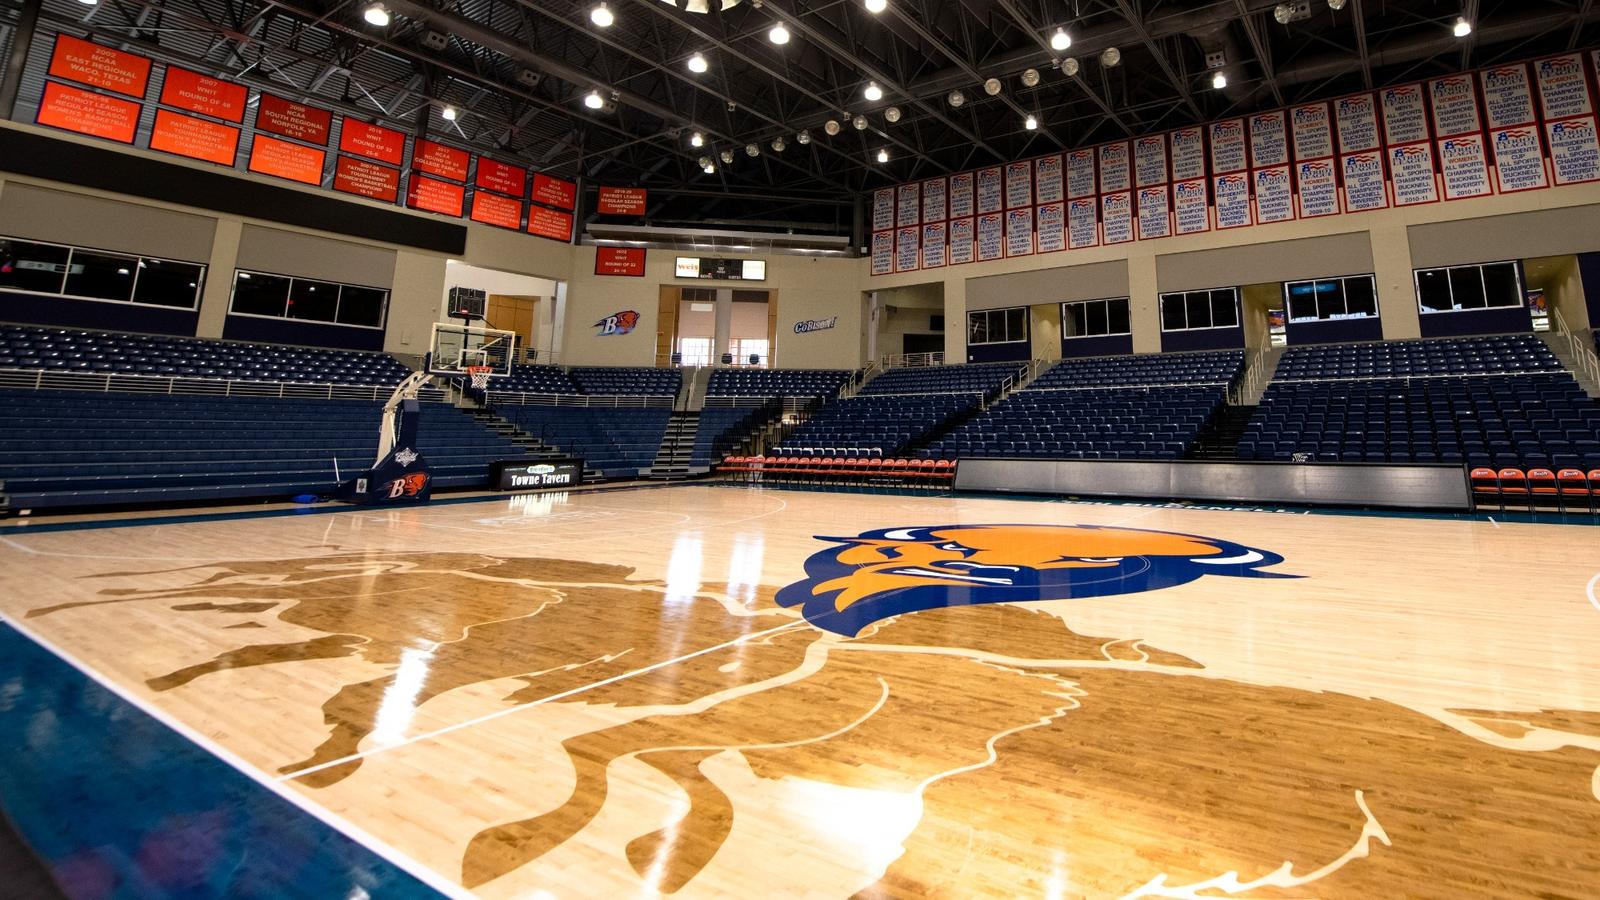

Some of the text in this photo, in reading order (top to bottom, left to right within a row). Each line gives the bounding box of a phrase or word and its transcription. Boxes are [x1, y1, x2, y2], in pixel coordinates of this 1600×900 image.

[95, 47, 116, 58] 2002
[90, 53, 117, 65] NCAA
[64, 53, 137, 79] EAST REGIONAL
[102, 71, 131, 85] TEXAS
[1544, 73, 1577, 84] WOMEN'S
[1556, 79, 1584, 89] SPORTS
[1543, 85, 1584, 98] CHAMPIONS
[178, 89, 208, 102] ROUND
[208, 98, 220, 106] OF
[1546, 92, 1583, 104] BUCKNELL
[1546, 99, 1586, 110] UNIVERSITY
[286, 109, 305, 119] NCAA
[1553, 107, 1582, 116] 2001-02
[264, 109, 324, 130] SOUTH REGIONAL
[307, 127, 317, 135] VA
[365, 133, 381, 141] WNIT
[352, 137, 375, 148] ROUND
[375, 143, 384, 151] OF
[1567, 144, 1583, 152] CUP
[1569, 148, 1598, 157] SPORTS
[1447, 154, 1477, 164] WOMEN'S
[1457, 160, 1483, 168] SPORTS
[1513, 156, 1540, 165] SPORTS
[1556, 154, 1598, 165] CHAMPIONS
[1402, 163, 1420, 171] MEN'S
[1500, 162, 1540, 173] CHAMPIONS
[1558, 160, 1597, 170] BUCKNELL
[346, 164, 390, 179] PATRIOT LEAGUE
[1406, 168, 1431, 176] SPORTS
[1445, 166, 1483, 177] CHAMPIONS
[1502, 168, 1539, 178] BUCKNELL
[1558, 166, 1599, 176] UNIVERSITY
[350, 170, 385, 183] TOURNAMENT
[1303, 177, 1329, 185] WOMEN'S
[1395, 174, 1431, 184] CHAMPIONS
[1448, 173, 1482, 183] BUCKNELL
[1502, 174, 1541, 184] UNIVERSITY
[1566, 172, 1595, 181] 2012-13
[350, 181, 383, 192] CHAMPIONS
[364, 178, 397, 190] BASKETBALL
[1312, 182, 1334, 190] SPORTS
[1358, 179, 1382, 187] SPORTS
[1397, 181, 1429, 190] BUCKNELL
[1448, 180, 1484, 189] UNIVERSITY
[1509, 180, 1537, 188] 2010-11
[1302, 188, 1334, 197] CHAMPIONS
[1347, 185, 1382, 194] CHAMPIONS
[1350, 190, 1380, 199] BUCKNELL
[1397, 187, 1432, 196] UNIVERSITY
[1455, 187, 1481, 195] 2010-11
[1304, 194, 1333, 203] BUCKNELL
[1349, 195, 1382, 205] UNIVERSITY
[1404, 194, 1428, 202] 2010-11
[1303, 200, 1334, 209] UNIVERSITY
[1355, 201, 1378, 209] 2009-10
[511, 474, 570, 486] Towne Tavern
[389, 478, 405, 498] B
